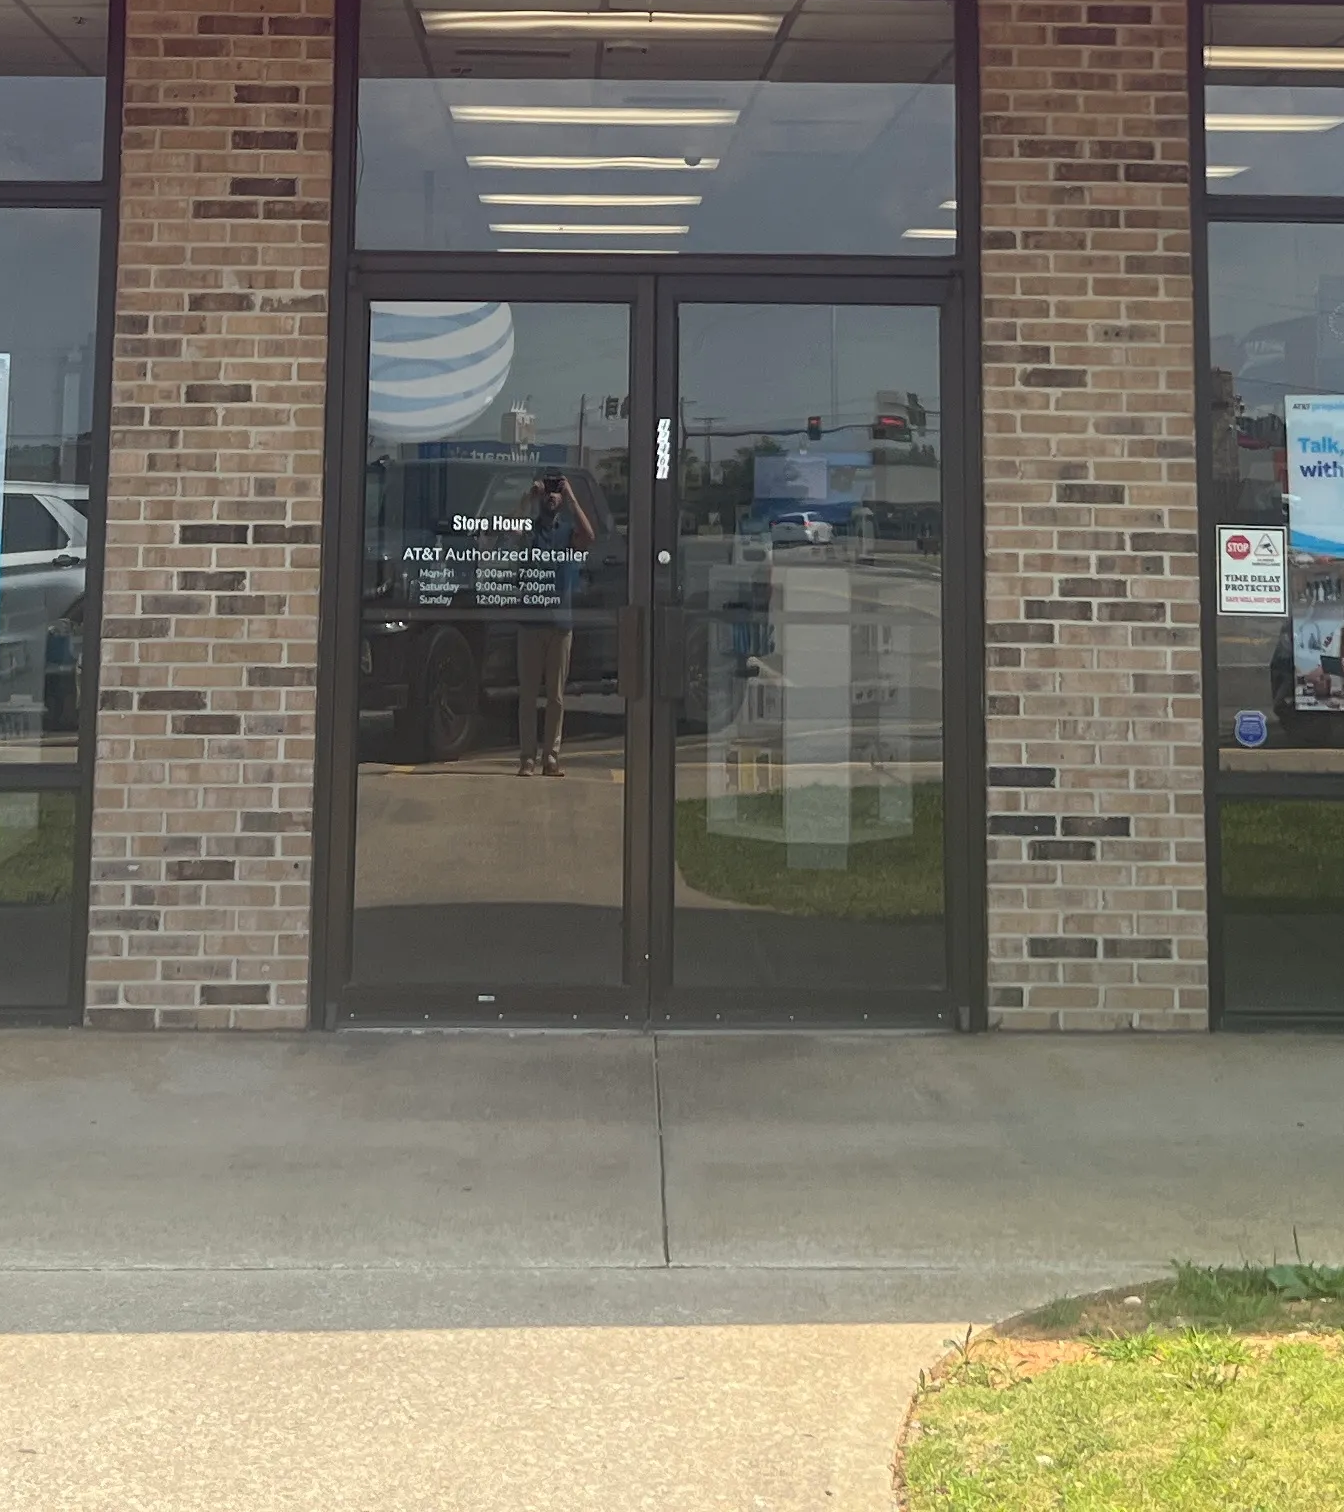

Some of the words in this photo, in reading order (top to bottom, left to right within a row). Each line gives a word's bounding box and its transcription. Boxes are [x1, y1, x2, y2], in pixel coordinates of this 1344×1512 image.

[1298, 437, 1344, 456] Talk,
[1300, 461, 1344, 478] with
[453, 515, 489, 531] Store
[493, 515, 533, 531] Hours
[1227, 542, 1249, 553] STOP
[403, 548, 442, 561] AT&T
[445, 547, 528, 562] Authorized
[532, 548, 590, 562] Retailer
[519, 569, 556, 580] 7:00pm
[1224, 574, 1248, 582] TIME
[1251, 575, 1281, 583] DELAY
[419, 582, 460, 593] Saturday
[519, 582, 556, 593] 7:00pm
[1224, 584, 1281, 592] PROTECTED
[419, 595, 453, 606] Sunday
[523, 595, 561, 606] 6:00pm
